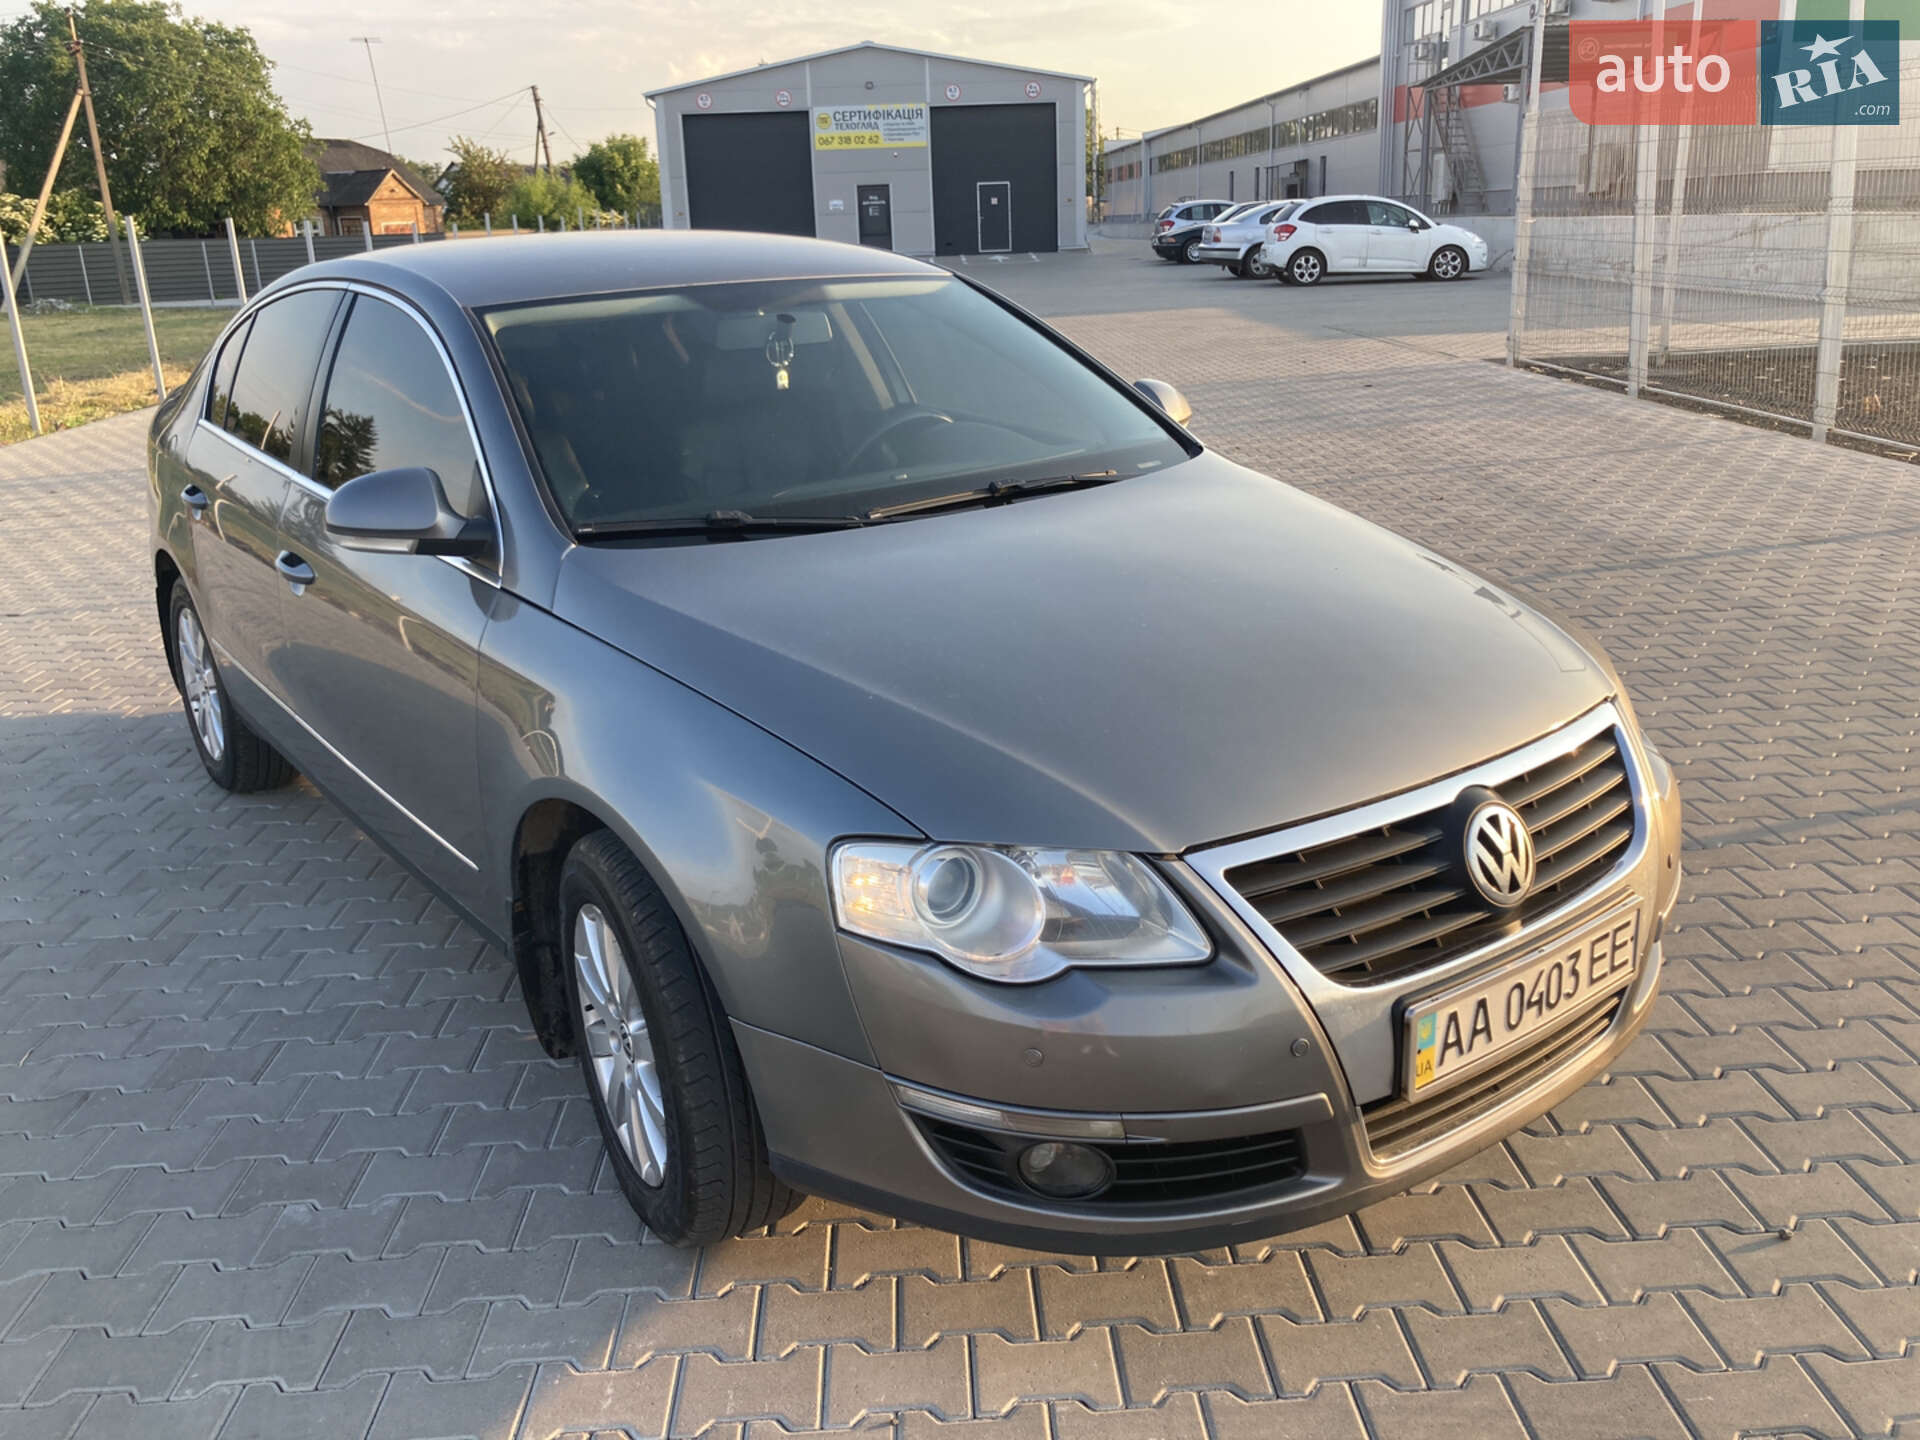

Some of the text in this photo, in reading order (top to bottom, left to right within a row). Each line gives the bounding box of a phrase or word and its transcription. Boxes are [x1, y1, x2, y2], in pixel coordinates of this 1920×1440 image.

[833, 108, 924, 122] СЕРТИФІКАЦІЯ
[835, 122, 880, 131] ТЕХОГЛЯД
[817, 136, 834, 146] 067
[854, 135, 866, 145] 02
[868, 135, 880, 144] 62
[1437, 920, 1632, 1068] AA 0403 EE
